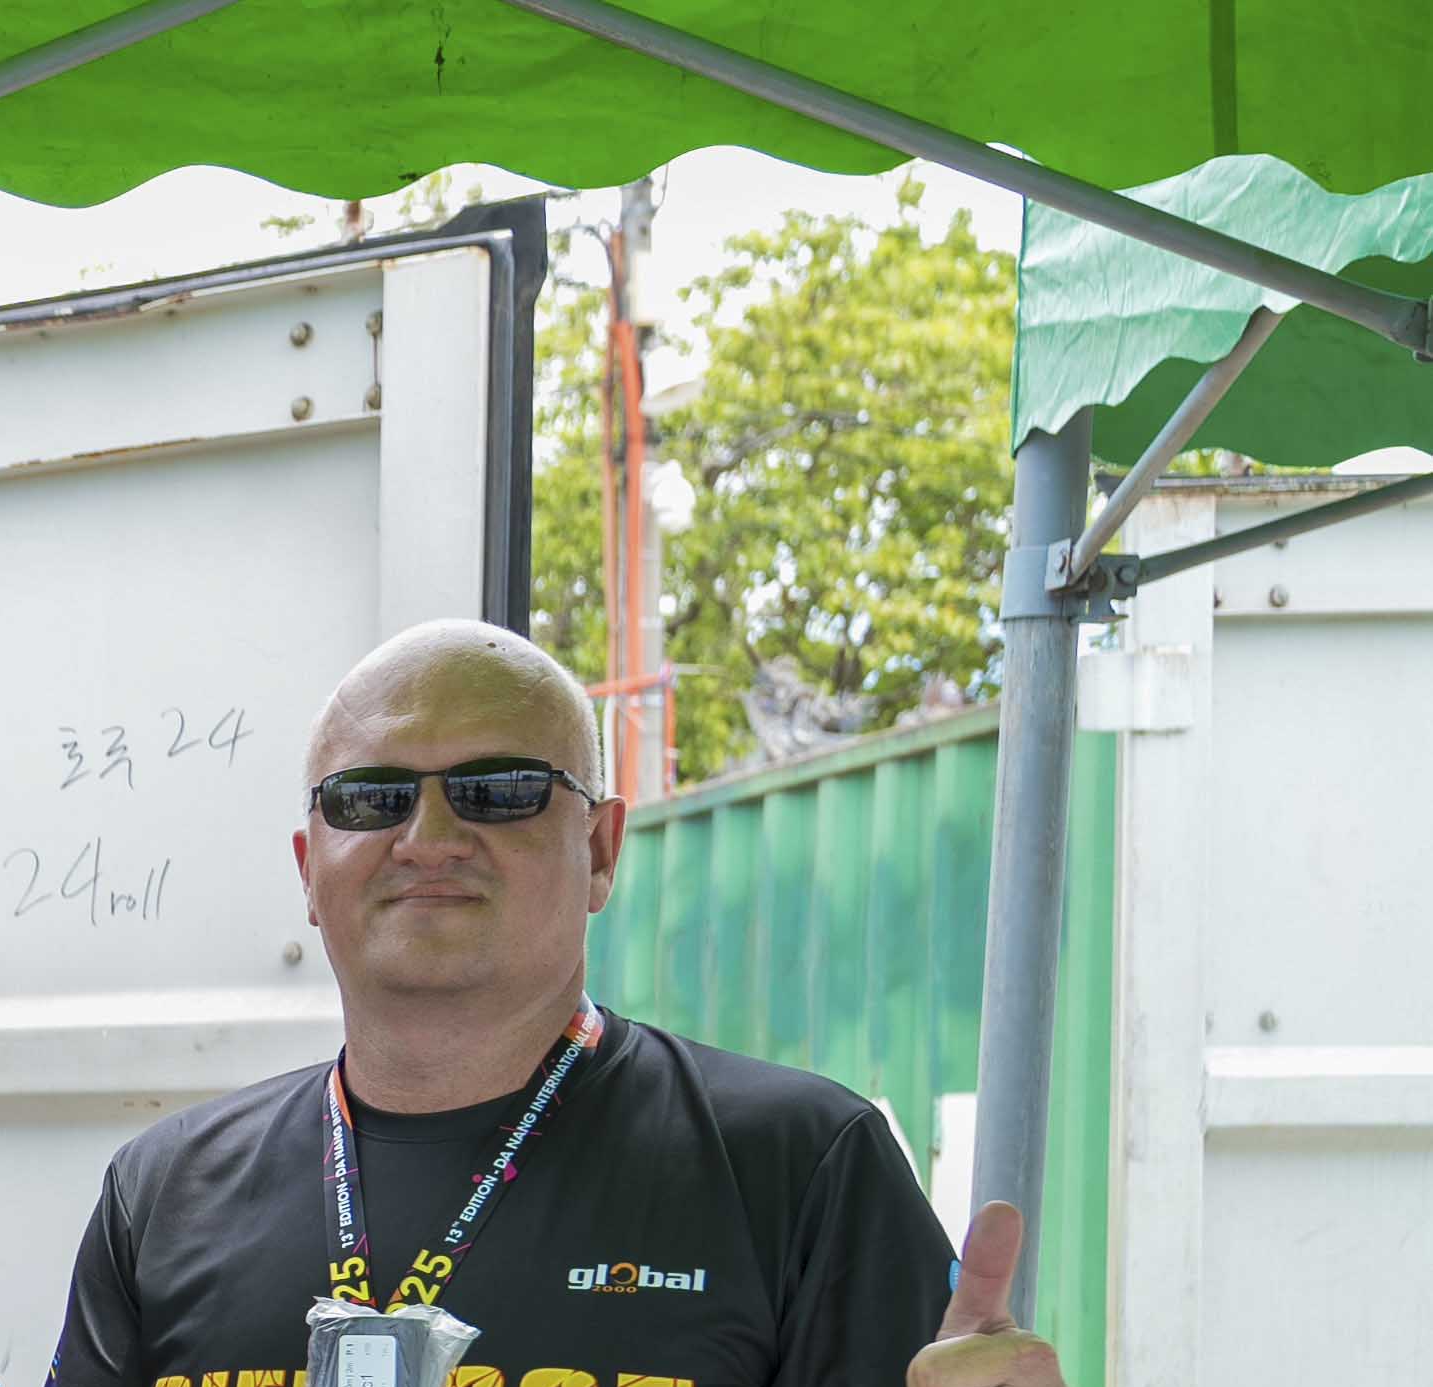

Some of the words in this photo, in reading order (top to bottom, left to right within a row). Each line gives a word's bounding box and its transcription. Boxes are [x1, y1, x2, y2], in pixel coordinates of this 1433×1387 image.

[160, 706, 254, 768] 24
[459, 1174, 498, 1224] EDITION
[493, 1150, 515, 1170] DA
[508, 1112, 537, 1151] NANG
[528, 1031, 590, 1113] INTERNATIONAL
[335, 1160, 349, 1178] DA
[337, 1186, 353, 1227] EDITION
[568, 1262, 707, 1291] global
